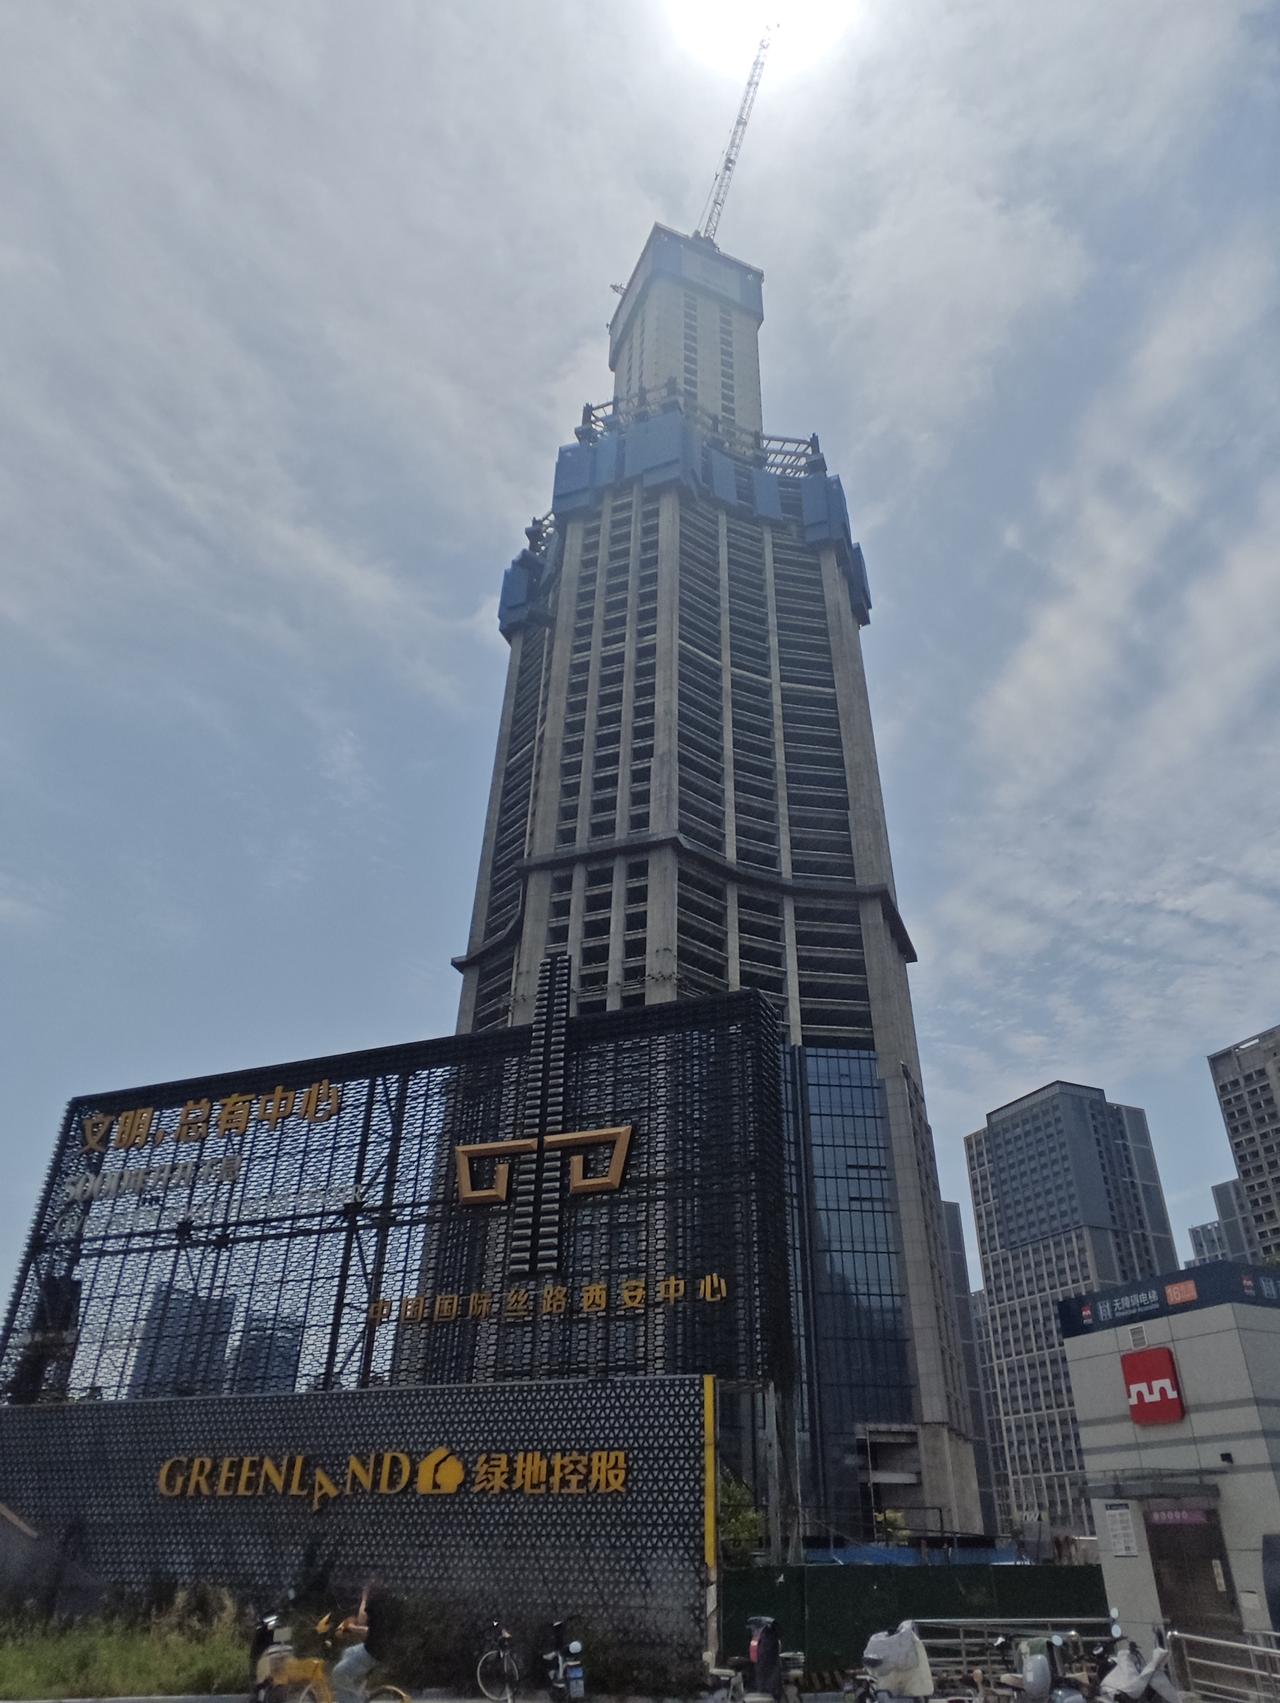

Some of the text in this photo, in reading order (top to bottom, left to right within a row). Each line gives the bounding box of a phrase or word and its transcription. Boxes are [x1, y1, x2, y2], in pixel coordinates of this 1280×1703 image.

[369, 1273, 727, 1323] 中国国际丝路西安中心
[158, 1451, 629, 1512] GREENLAND 绿地控股
